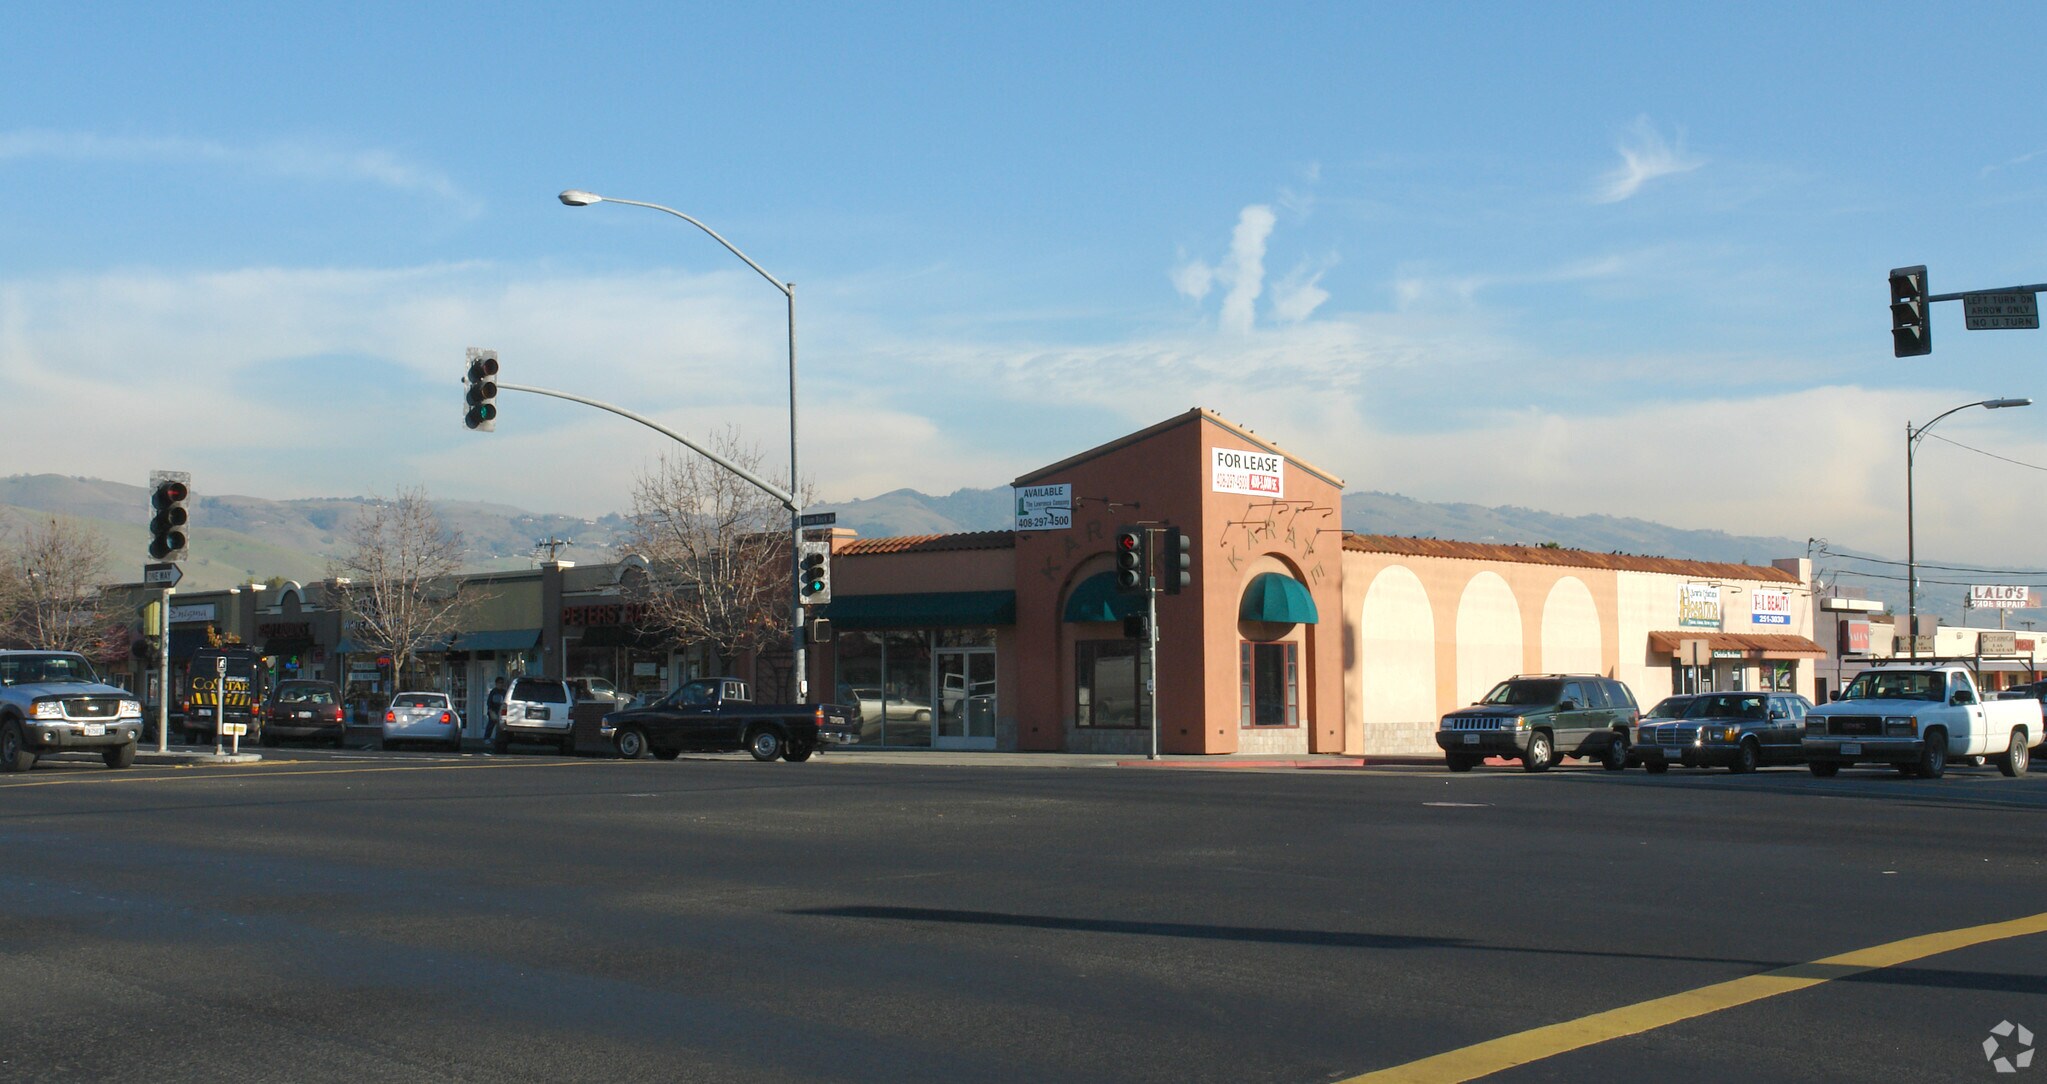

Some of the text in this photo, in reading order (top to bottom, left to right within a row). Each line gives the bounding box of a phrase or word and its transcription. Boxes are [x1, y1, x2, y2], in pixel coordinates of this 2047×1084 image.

[1967, 294, 2033, 305] LEFT TURN ON
[1972, 304, 2029, 315] ARROW ONLY
[1972, 317, 2033, 327] NO U TURN
[1217, 452, 1278, 473] FOR LEASE
[1023, 486, 1064, 499] AVAILABLE
[1018, 515, 1069, 529] 408-297-4500
[148, 570, 172, 582] ONE WAY
[1974, 586, 2024, 599] LALO'S
[1767, 595, 1790, 611] BEAUTY
[1996, 600, 2026, 608] REPAIR
